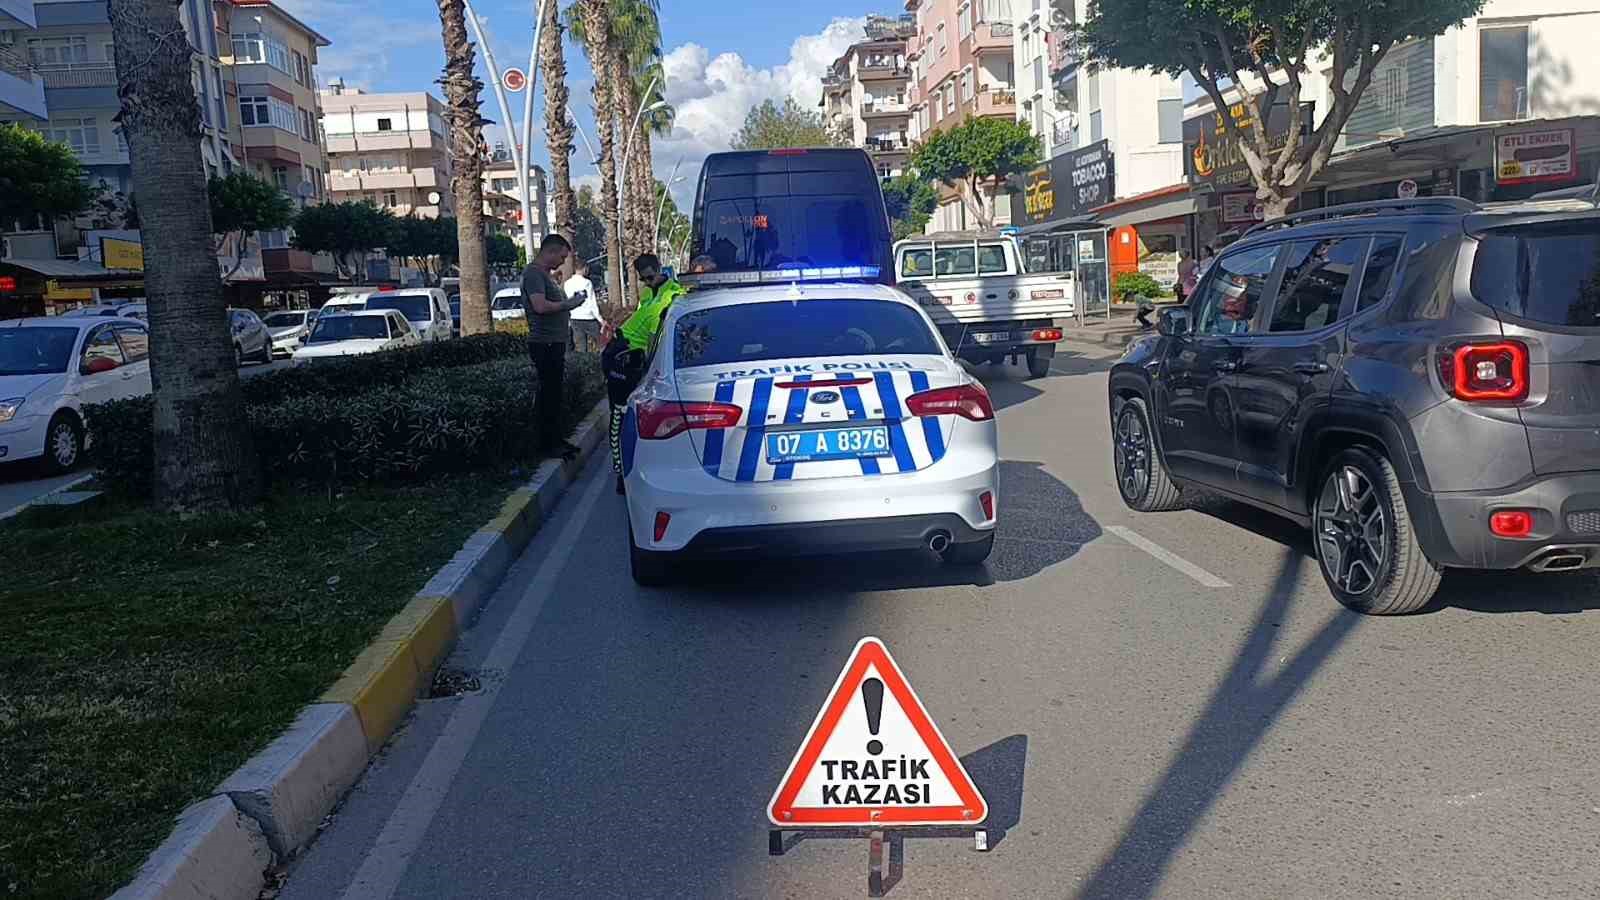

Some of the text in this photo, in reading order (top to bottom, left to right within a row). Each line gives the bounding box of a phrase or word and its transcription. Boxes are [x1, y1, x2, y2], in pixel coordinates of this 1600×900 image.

[1072, 161, 1107, 187] TOBACCO
[1079, 184, 1099, 204] SHOP
[713, 364, 814, 379] TRAFİK
[777, 429, 886, 455] 07 A 8376
[821, 754, 930, 780] TRAFİK
[822, 783, 931, 805] KAZASI
